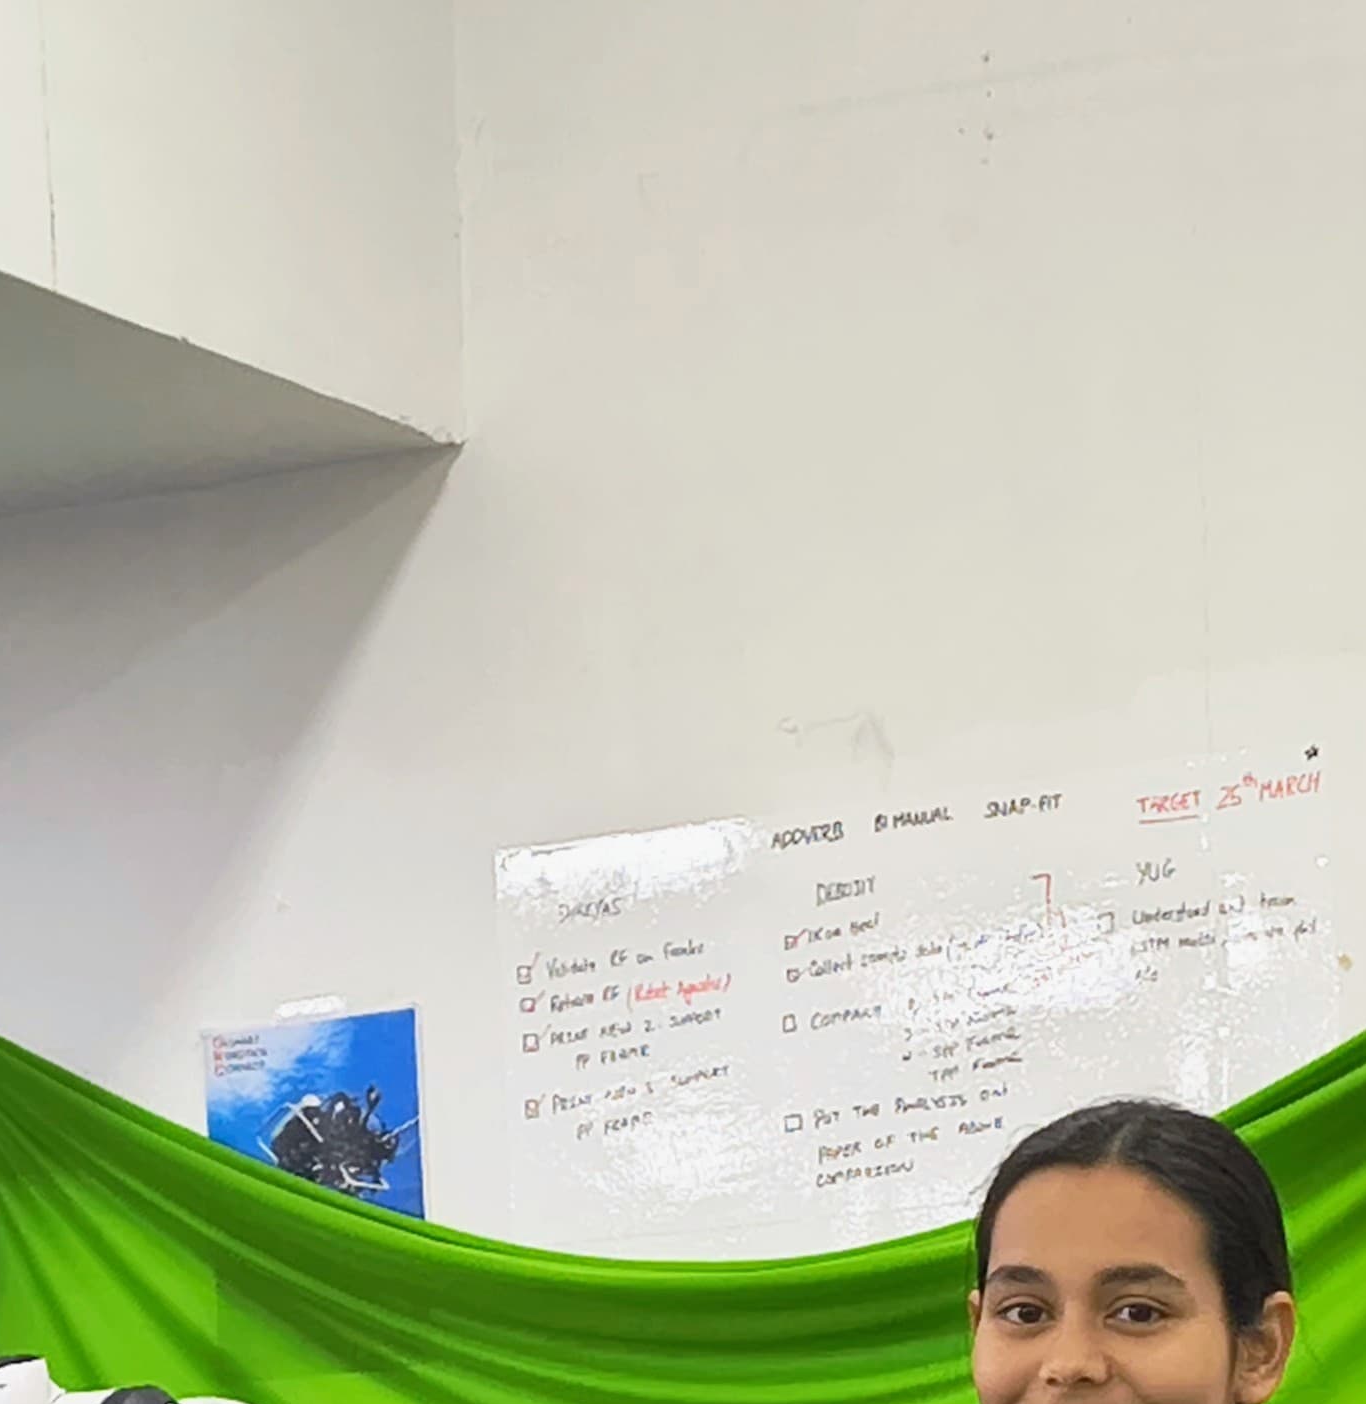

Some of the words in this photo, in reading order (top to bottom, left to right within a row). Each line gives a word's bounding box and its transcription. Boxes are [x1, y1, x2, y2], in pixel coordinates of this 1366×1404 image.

[1135, 789, 1202, 815] TARGET
[1259, 770, 1322, 803] MARCH
[770, 820, 845, 850] ADDVERB
[1136, 857, 1177, 886] YUG
